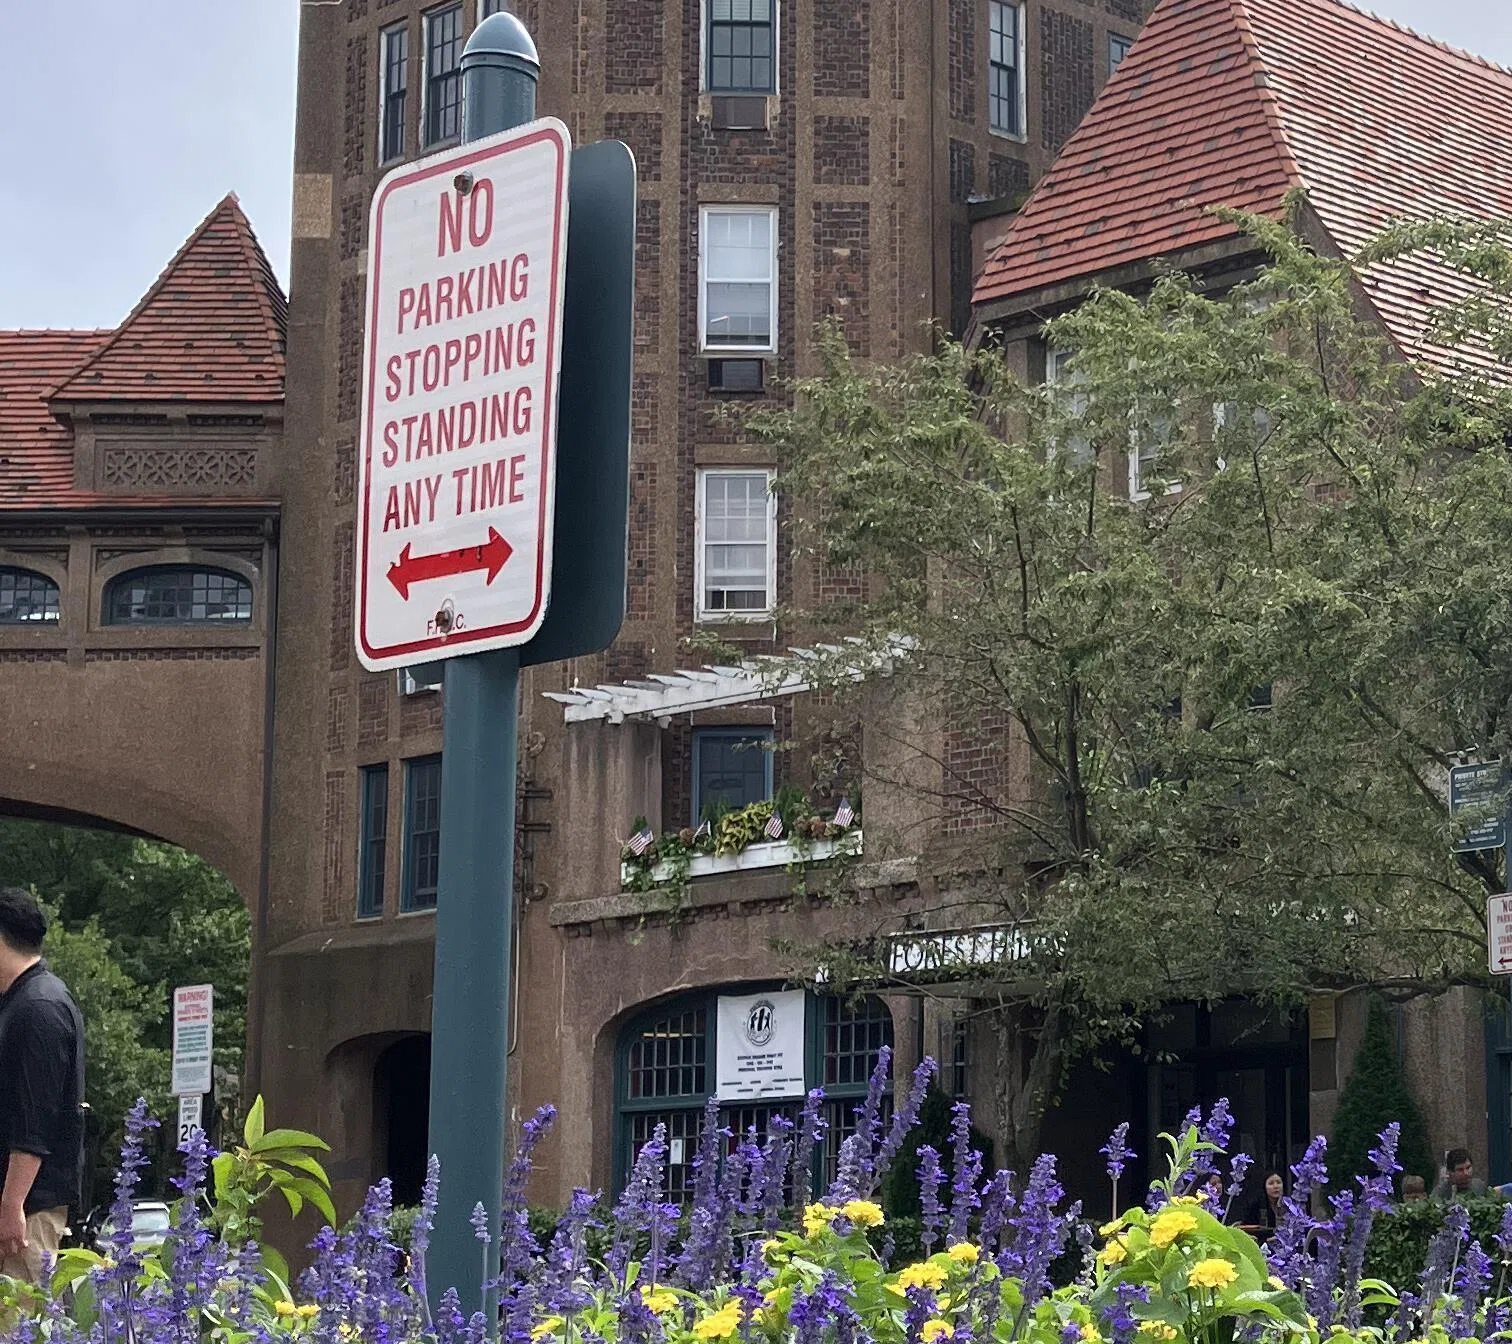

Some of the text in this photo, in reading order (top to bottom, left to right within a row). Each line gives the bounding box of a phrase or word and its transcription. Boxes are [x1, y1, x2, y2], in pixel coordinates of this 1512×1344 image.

[438, 178, 494, 257] NO
[398, 253, 529, 334] PARKING
[385, 318, 535, 402] STOPPING
[382, 386, 532, 468] STANDING
[383, 454, 526, 532] ANY TIME
[1503, 900, 1512, 912] NO
[1505, 924, 1512, 933] OR
[178, 990, 208, 1002] WARNING!
